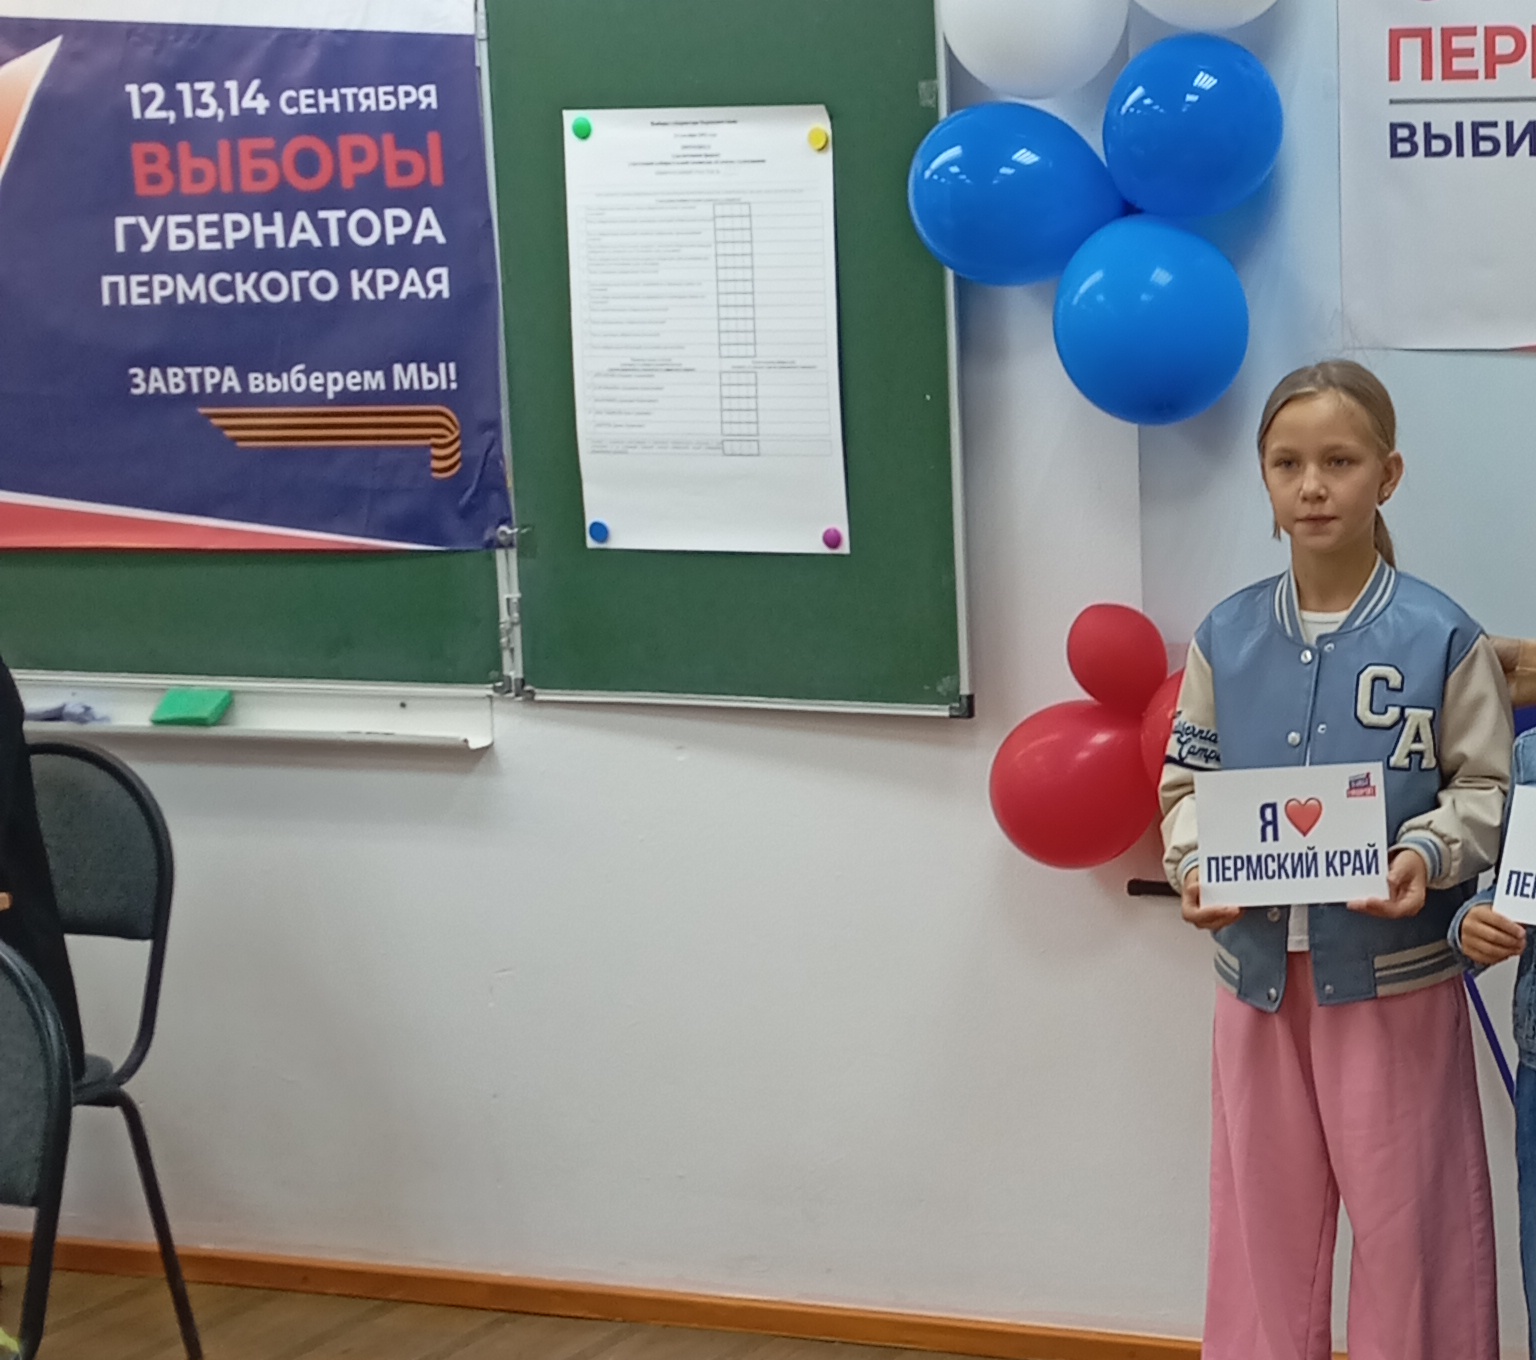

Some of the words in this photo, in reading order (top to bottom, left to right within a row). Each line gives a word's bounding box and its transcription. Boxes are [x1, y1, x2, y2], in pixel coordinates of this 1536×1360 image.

[124, 78, 270, 124] 12,13,14
[279, 84, 438, 115] СЕНТЯБРЯ
[131, 131, 445, 197] ВЫБОРЫ
[114, 206, 447, 253] ГУБЕРНАТОРА
[101, 269, 339, 306] ПЕРМСКОГО
[350, 266, 450, 301] КРАЯ
[128, 366, 242, 395] ЗАВТРА
[247, 363, 386, 400] выберем
[392, 361, 458, 391] МЫ!
[1259, 802, 1280, 843] Я
[1206, 845, 1319, 883] ПЕРМСКИЙ
[1325, 842, 1380, 878] КРАЙ
